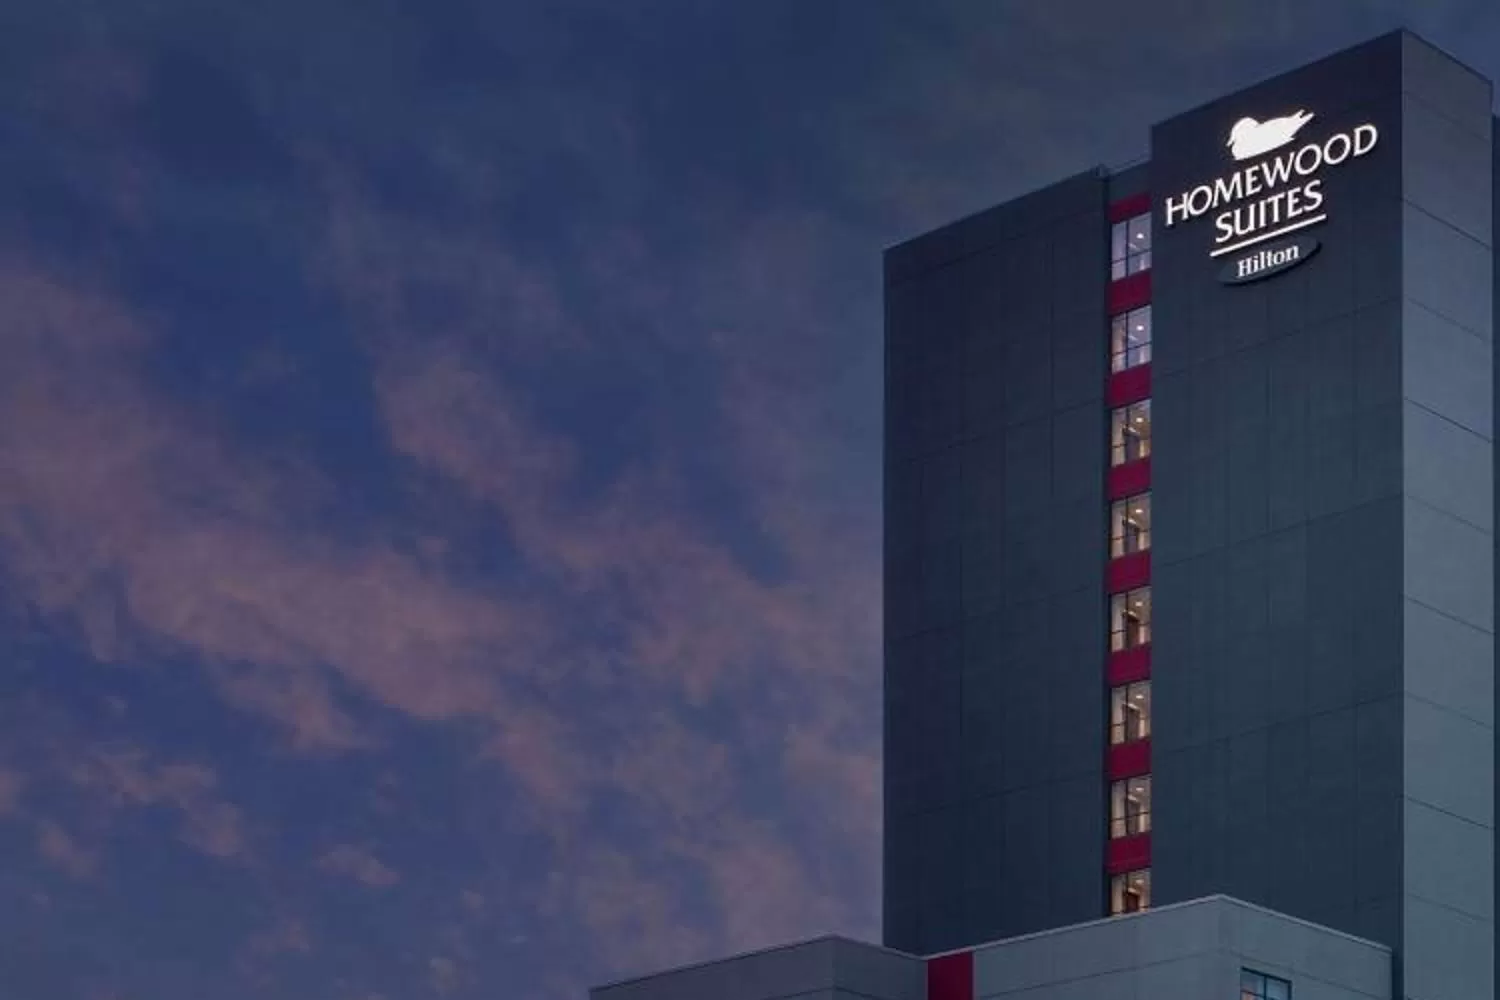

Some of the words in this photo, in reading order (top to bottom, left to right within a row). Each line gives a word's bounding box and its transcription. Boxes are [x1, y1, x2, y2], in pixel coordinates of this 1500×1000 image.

[1164, 124, 1378, 226] HOMEWOOD
[1215, 179, 1323, 243] SUITES
[1236, 245, 1299, 278] Hilton
